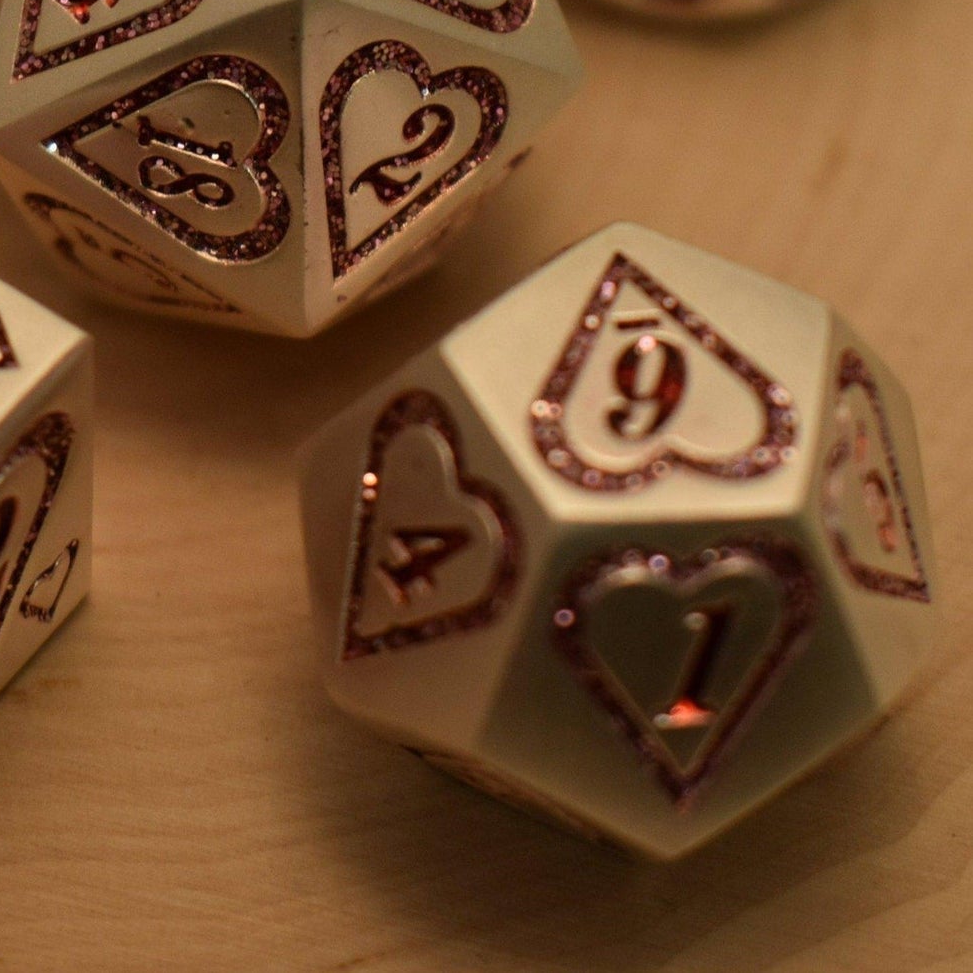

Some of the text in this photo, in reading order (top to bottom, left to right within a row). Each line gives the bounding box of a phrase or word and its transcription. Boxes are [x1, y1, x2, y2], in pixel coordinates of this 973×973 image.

[137, 114, 238, 209] 18
[349, 102, 456, 206] 2
[378, 528, 471, 606] 4
